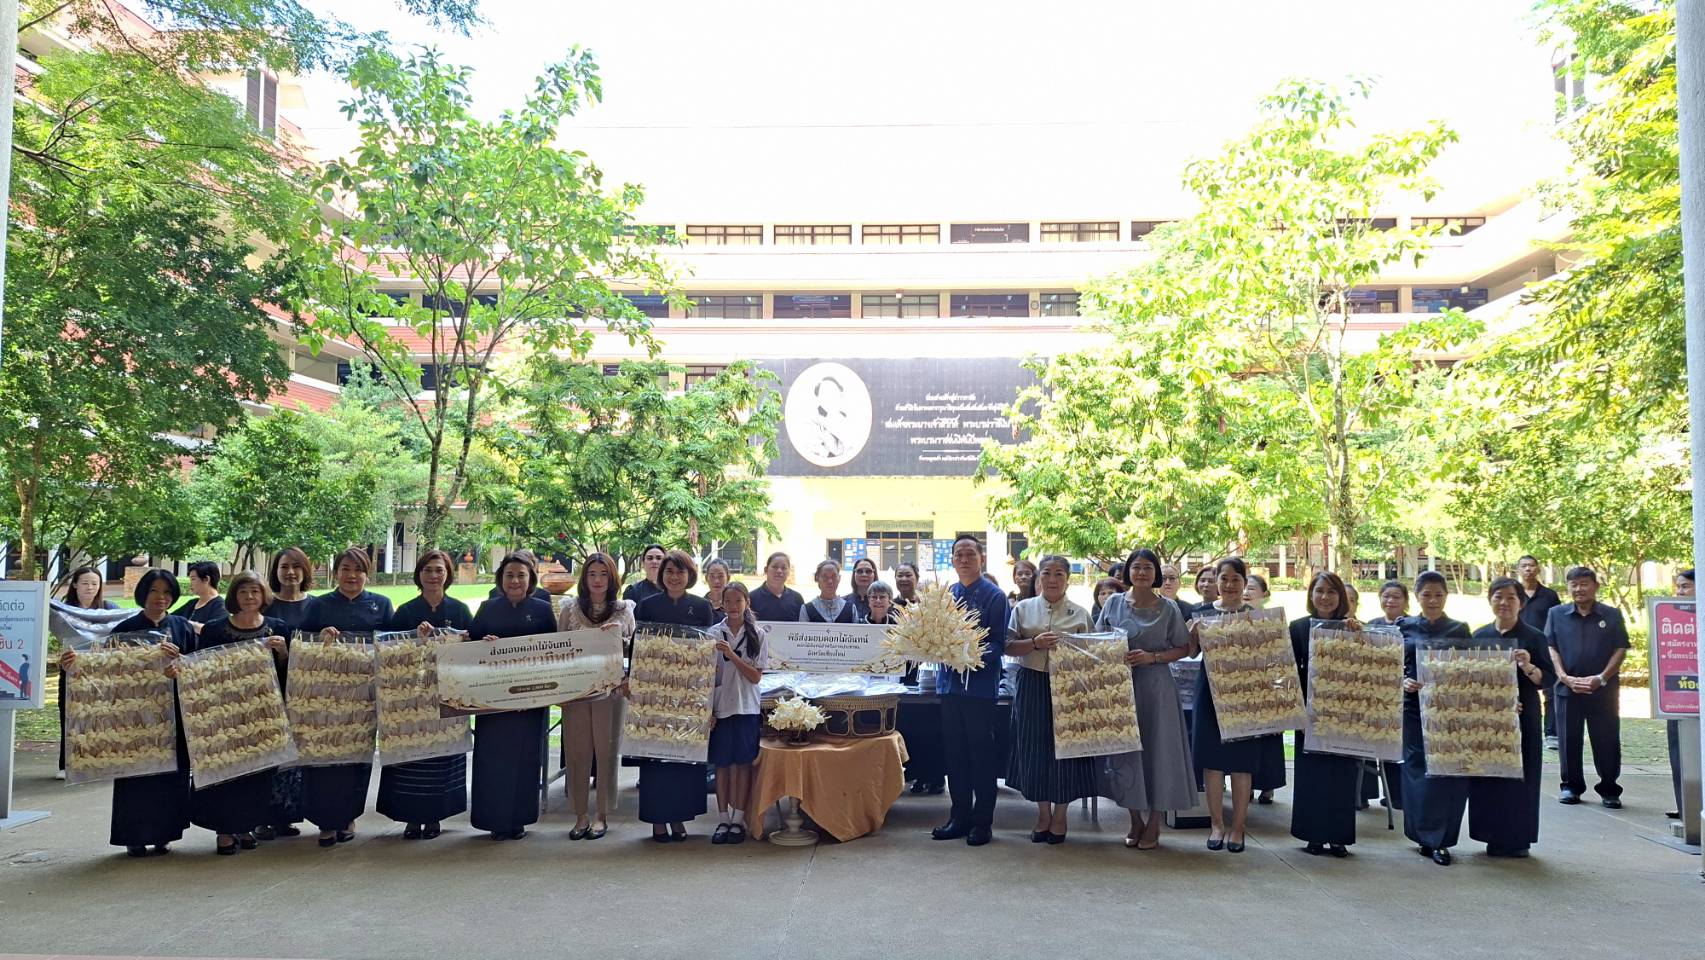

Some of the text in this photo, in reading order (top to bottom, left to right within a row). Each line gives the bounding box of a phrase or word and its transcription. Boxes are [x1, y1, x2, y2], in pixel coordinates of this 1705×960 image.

[788, 632, 869, 643] พิธีส่งมอบดอกไม้จันทน์
[18, 639, 24, 649] 2
[490, 639, 572, 656] ส่งมอบดอกไม้จันทน์
